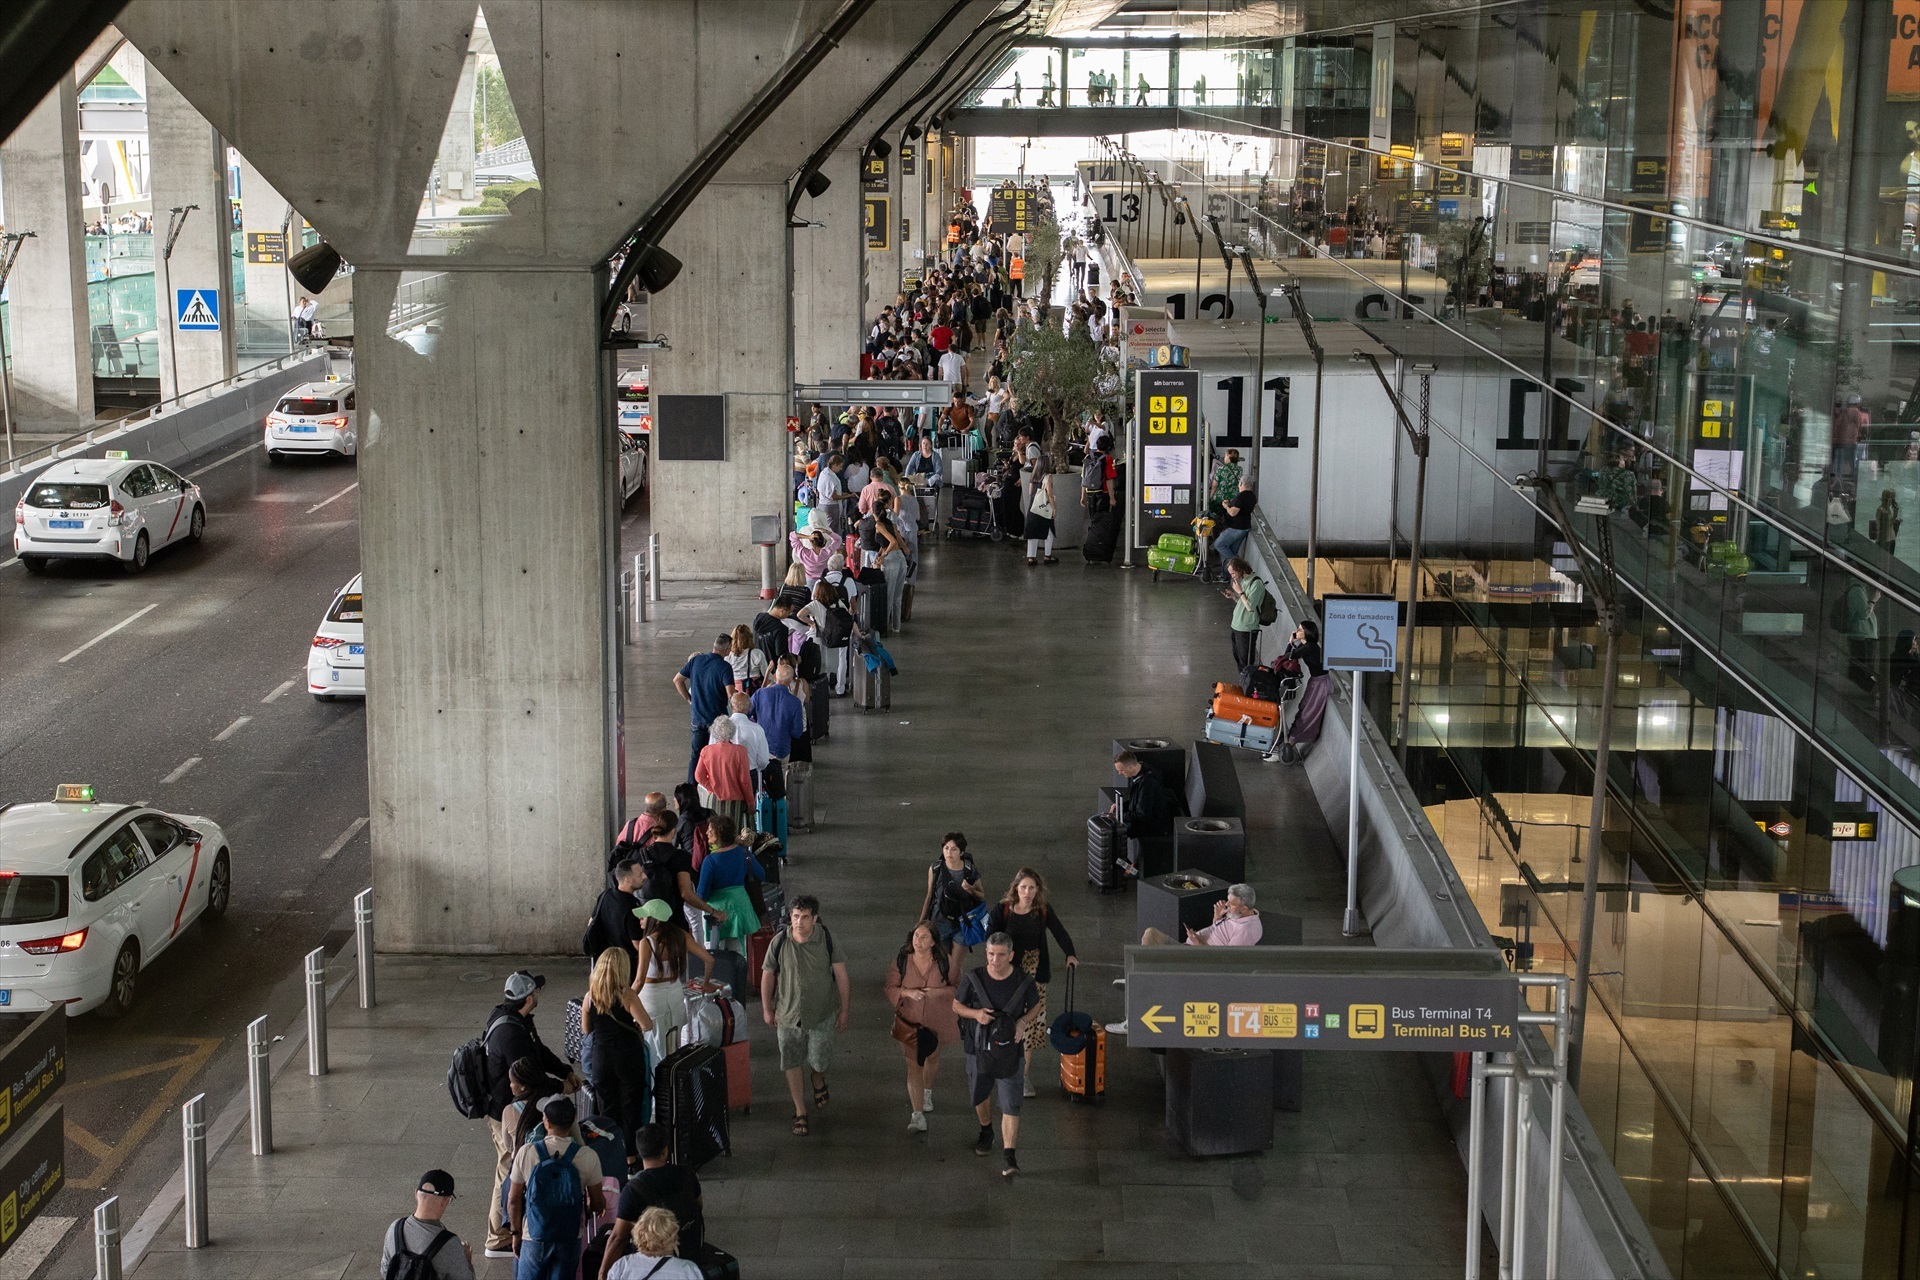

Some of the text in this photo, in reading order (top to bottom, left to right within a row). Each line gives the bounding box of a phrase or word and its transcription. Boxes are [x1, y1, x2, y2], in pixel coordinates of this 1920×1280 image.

[1102, 193, 1140, 223] 13
[1216, 376, 1299, 448] 11
[1264, 1015, 1279, 1026] BUS
[1306, 1007, 1319, 1017] T1
[1391, 1007, 1493, 1020] Bus Terminal T4
[1229, 1012, 1261, 1034] T4
[1305, 1027, 1319, 1037] T3
[1326, 1017, 1340, 1028] T2
[1392, 1023, 1511, 1038] Terminal Bus T4
[13, 1045, 56, 1097] Bus Terminal T4
[13, 1057, 64, 1117] Terminal Bus T4
[20, 1178, 31, 1198] City
[21, 1190, 40, 1219] Centro
